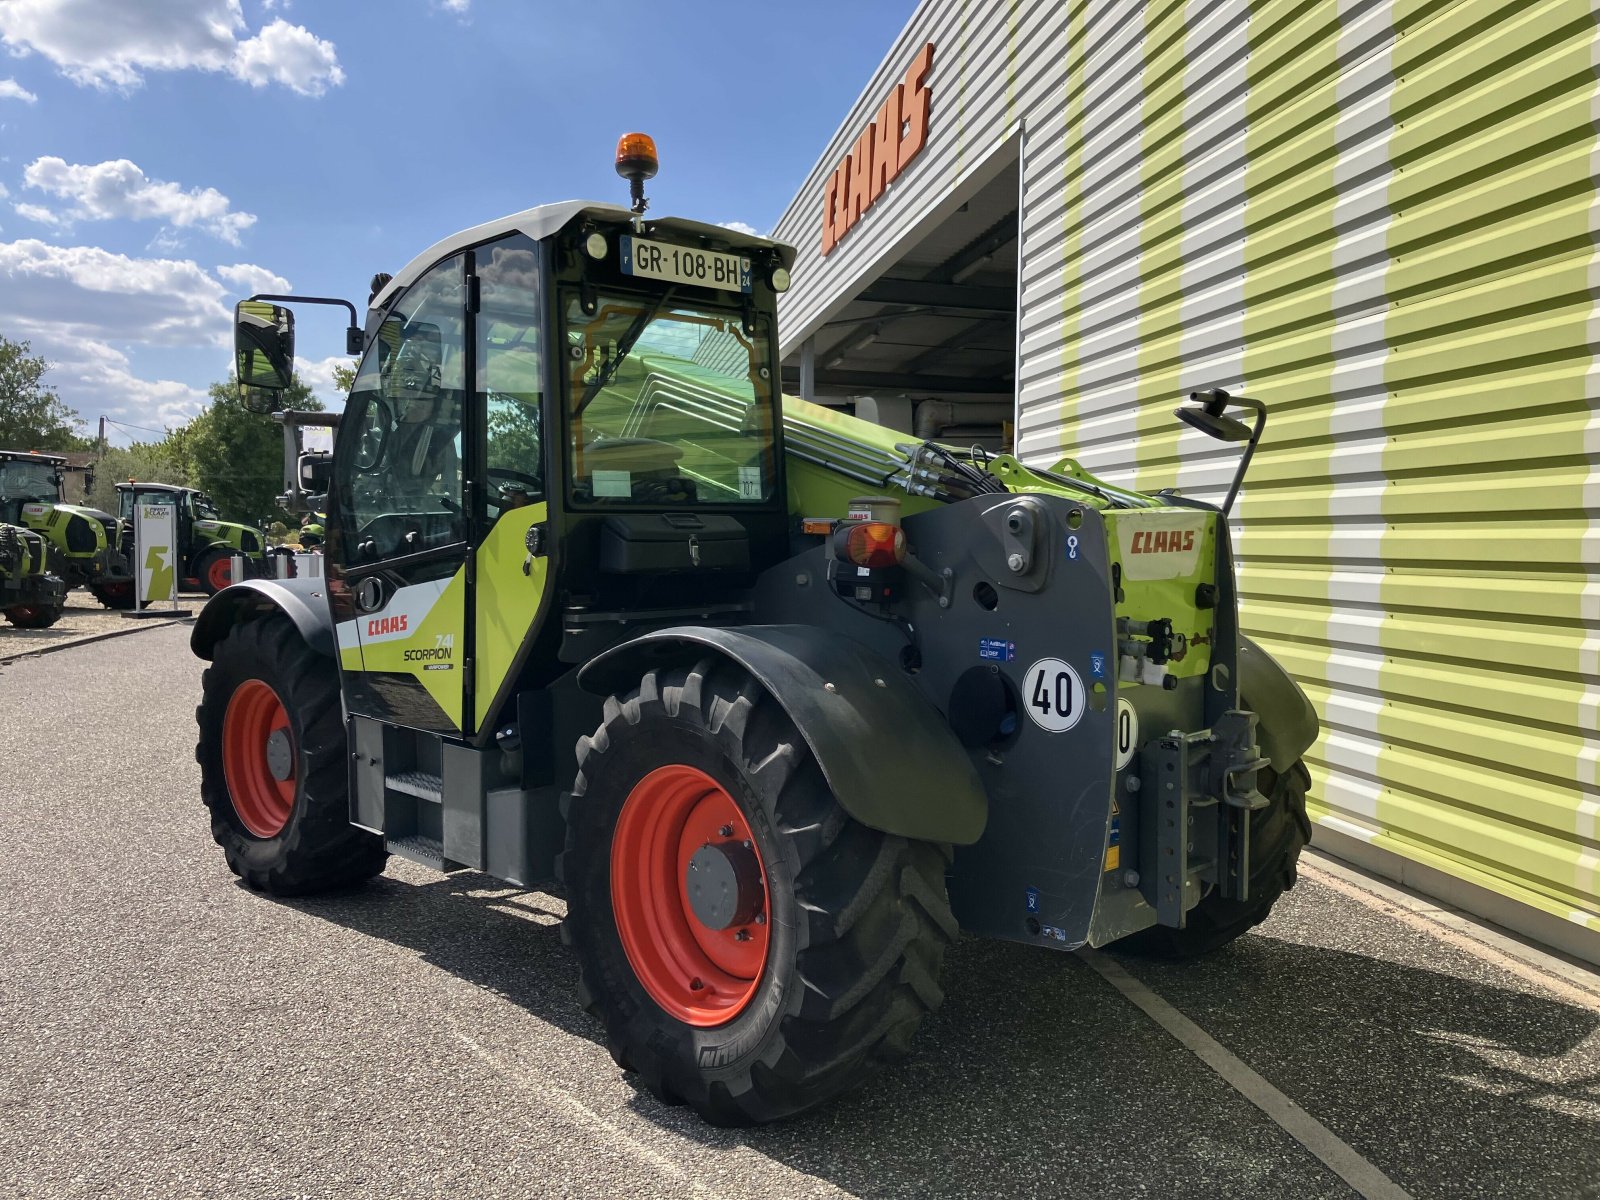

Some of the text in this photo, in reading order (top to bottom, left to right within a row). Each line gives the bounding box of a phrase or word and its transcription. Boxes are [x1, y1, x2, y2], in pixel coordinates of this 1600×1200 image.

[821, 43, 934, 257] CLAAS
[637, 244, 739, 285] GR-108-BH
[742, 275, 751, 287] 24
[1131, 530, 1195, 554] CLAAS
[368, 614, 408, 636] CLAAS
[404, 647, 452, 661] SCORPION
[1032, 669, 1073, 718] 40
[1119, 709, 1130, 754] 0
